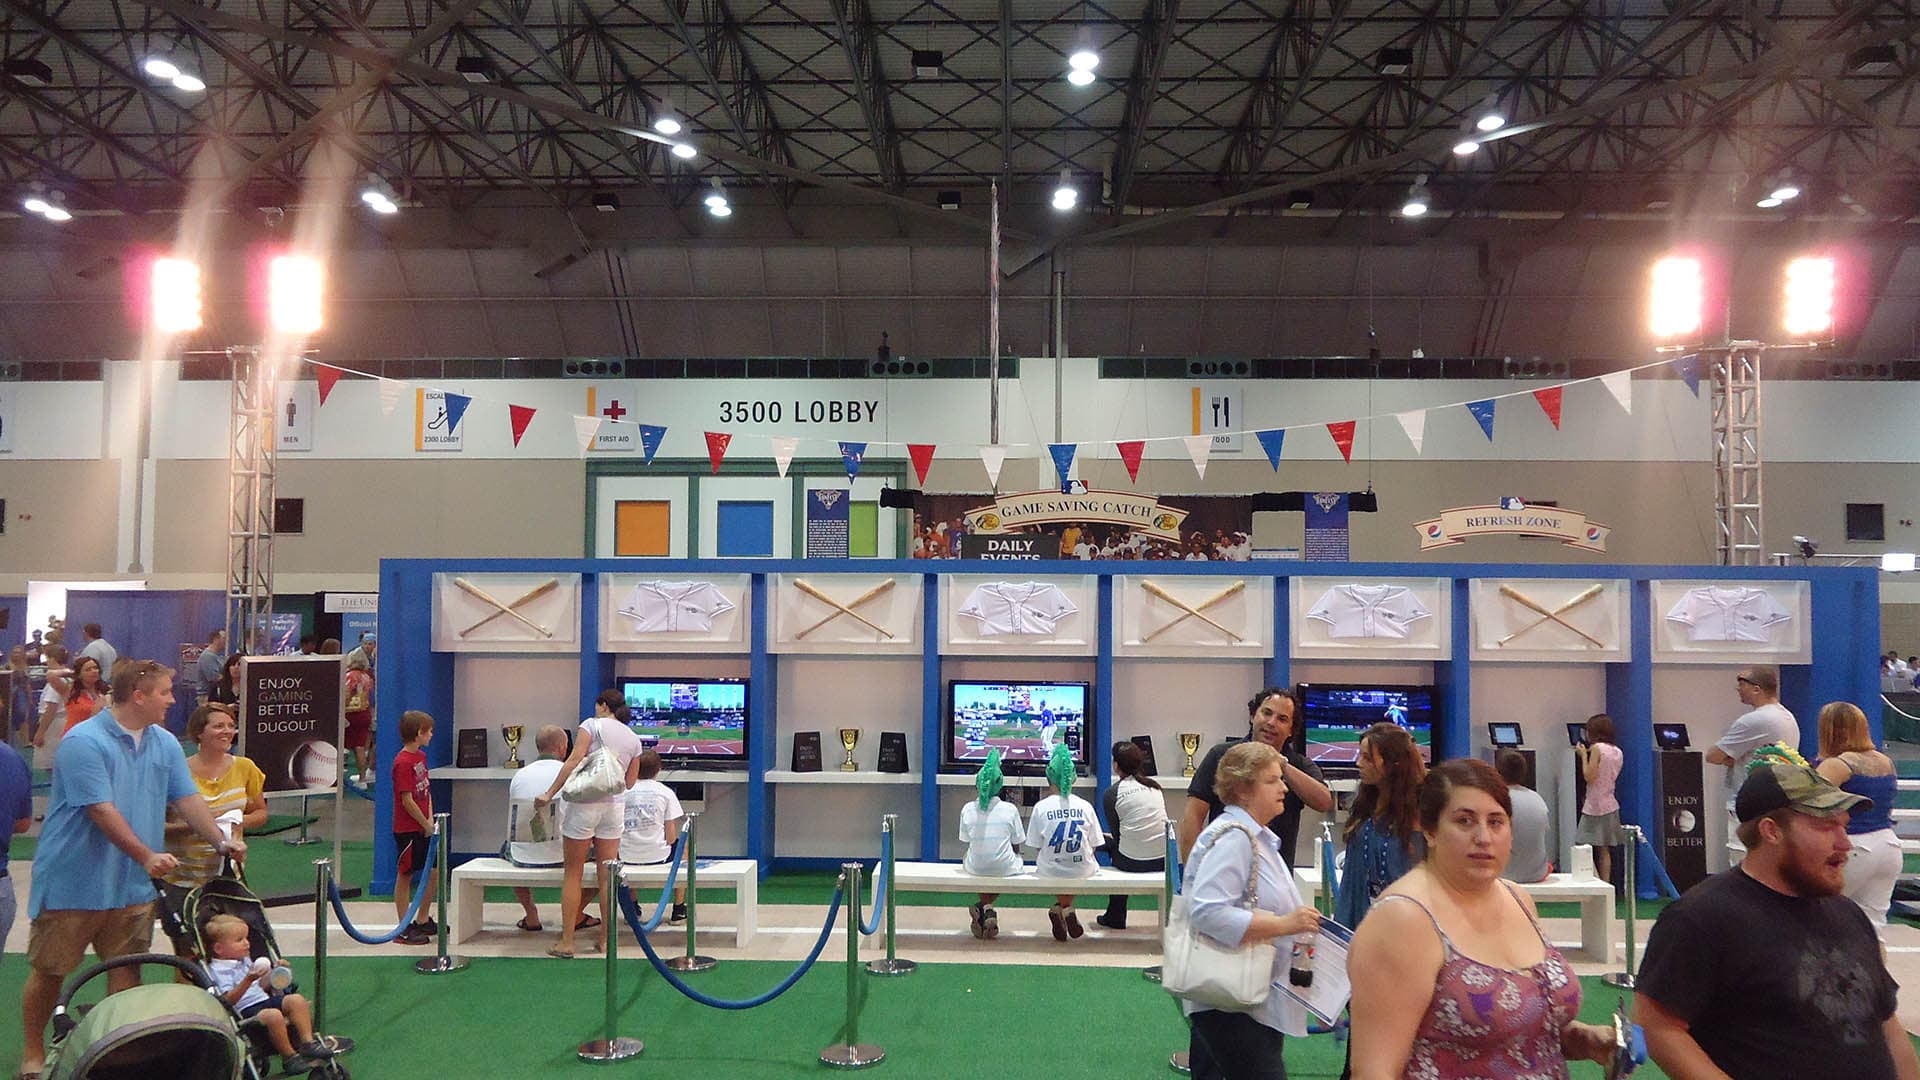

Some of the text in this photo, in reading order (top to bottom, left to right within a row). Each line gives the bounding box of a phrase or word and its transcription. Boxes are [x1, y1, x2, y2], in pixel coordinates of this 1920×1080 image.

[719, 401, 879, 423] 3500 LOBBY
[1001, 501, 1151, 518] GAME SAVING CATCH
[1466, 516, 1561, 529] REFRESH ZONE
[988, 540, 1034, 552] DAILY
[259, 677, 303, 690] ENJOY
[258, 690, 313, 702] GAMING
[258, 703, 310, 716] BETTER
[257, 719, 317, 733] DUGOUT
[1668, 795, 1699, 806] ENJOY
[1046, 808, 1084, 821] GIBSON
[1048, 820, 1086, 854] 45
[1667, 837, 1704, 847] BETTER
